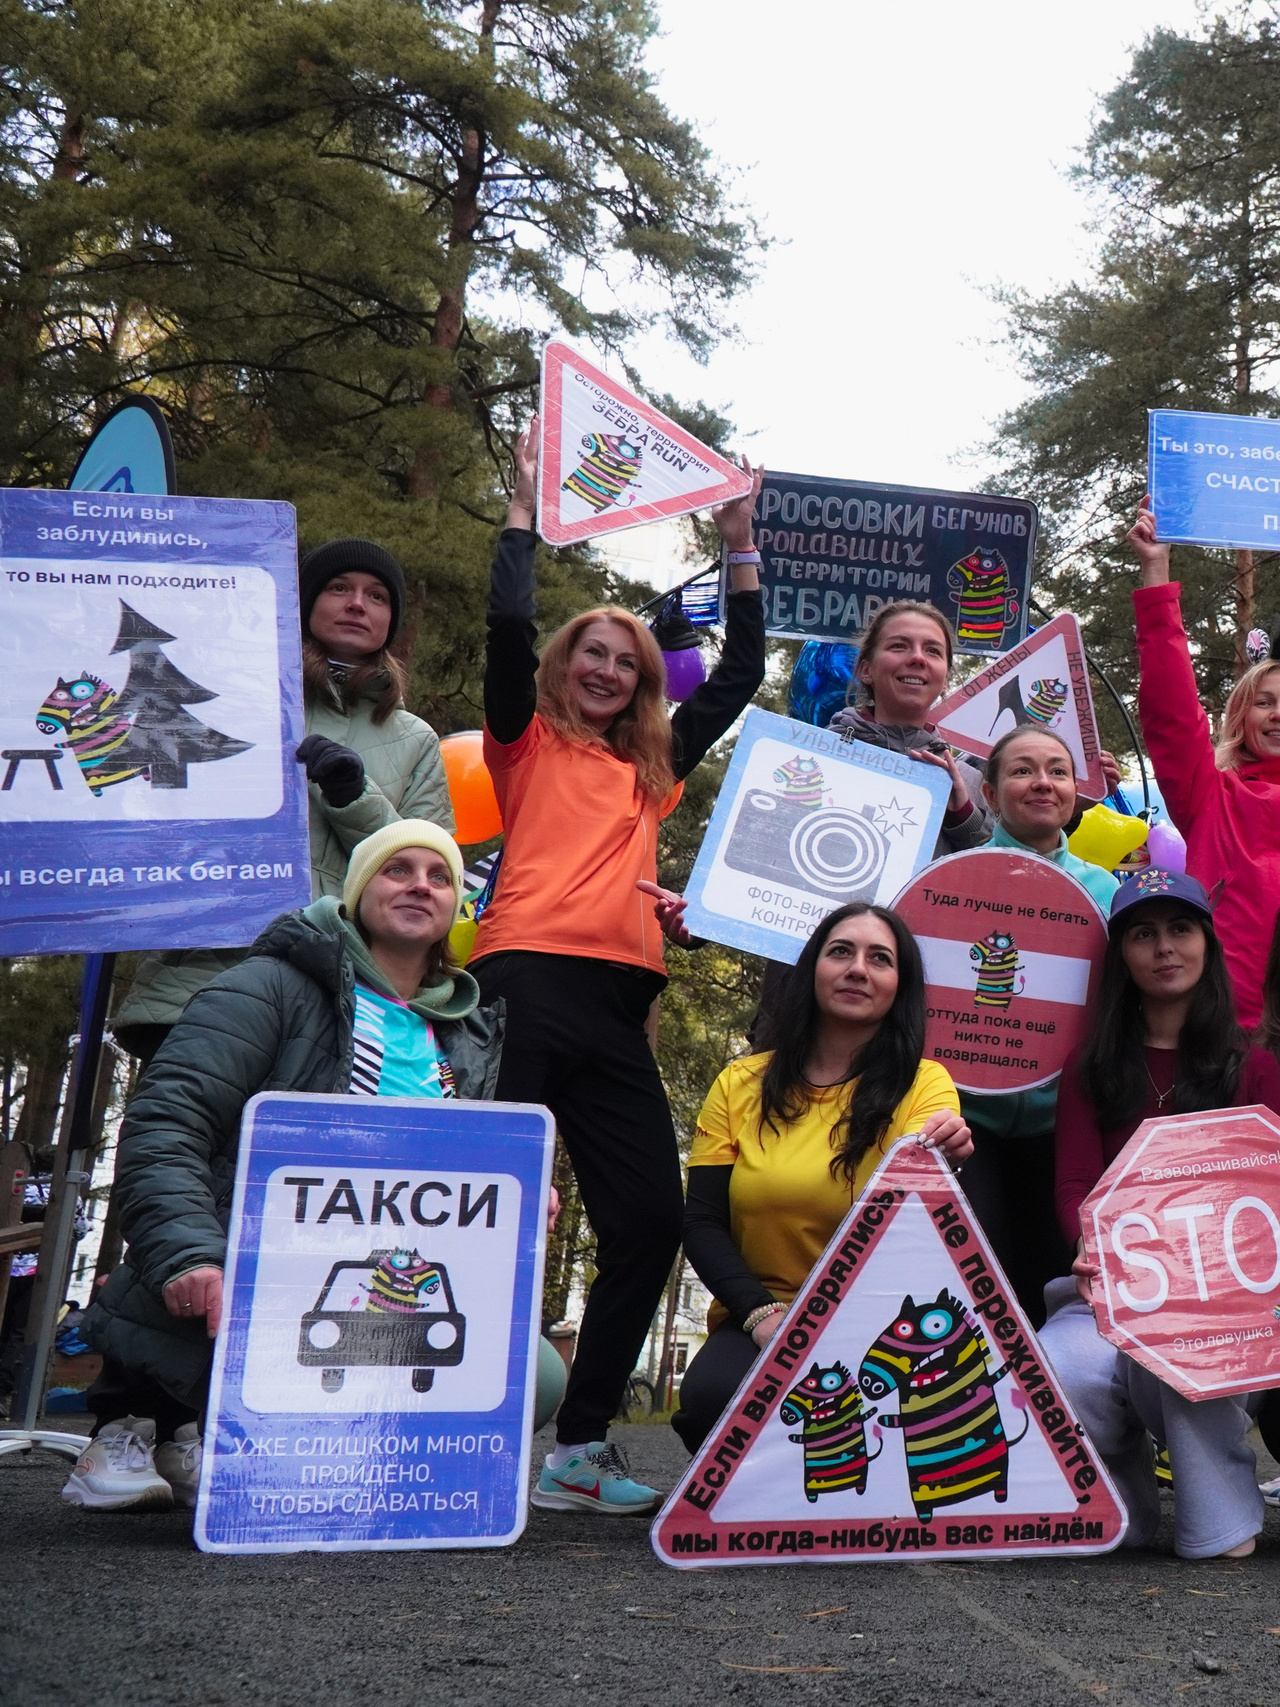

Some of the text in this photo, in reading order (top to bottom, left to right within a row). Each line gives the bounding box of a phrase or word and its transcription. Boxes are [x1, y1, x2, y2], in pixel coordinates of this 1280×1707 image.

[574, 373, 711, 474] Осторожно, территория
[592, 400, 689, 473] ЗЕБРА RUN
[1157, 436, 1188, 453] Ты
[1193, 441, 1235, 460] это,
[73, 501, 174, 521] Если вы
[751, 488, 1028, 538] РОССОВКИ БЕГУНОВ
[36, 524, 209, 549] заблудились,
[6, 570, 237, 590] то вы нам подходите!
[964, 644, 1032, 697] ОТ ЖЕНЫ
[1066, 651, 1095, 763] НЕ УБЕЖИШЬ
[20, 866, 125, 889] всегда
[131, 864, 185, 882] так
[190, 859, 293, 880] бегаем
[751, 906, 818, 937] КОНТРО
[922, 888, 1089, 926] Туда лучше не бегать
[926, 1008, 1056, 1035] оттуда пока ещё
[954, 1030, 1023, 1048] никто не
[933, 1047, 1038, 1070] возвращался
[284, 1176, 499, 1229] ТАКСИ
[684, 1185, 906, 1511] Если вы потерялись,
[932, 1201, 1099, 1506] не переживайте,
[1172, 1326, 1274, 1352] Это ловушка
[233, 1434, 505, 1459] УЖЕ СЛИШКОМ МНОГО
[250, 1490, 478, 1516] ЧТОБЫ СДАВАТЬСЯ
[671, 1517, 1104, 1555] мы когда-нибудь вас найдём
